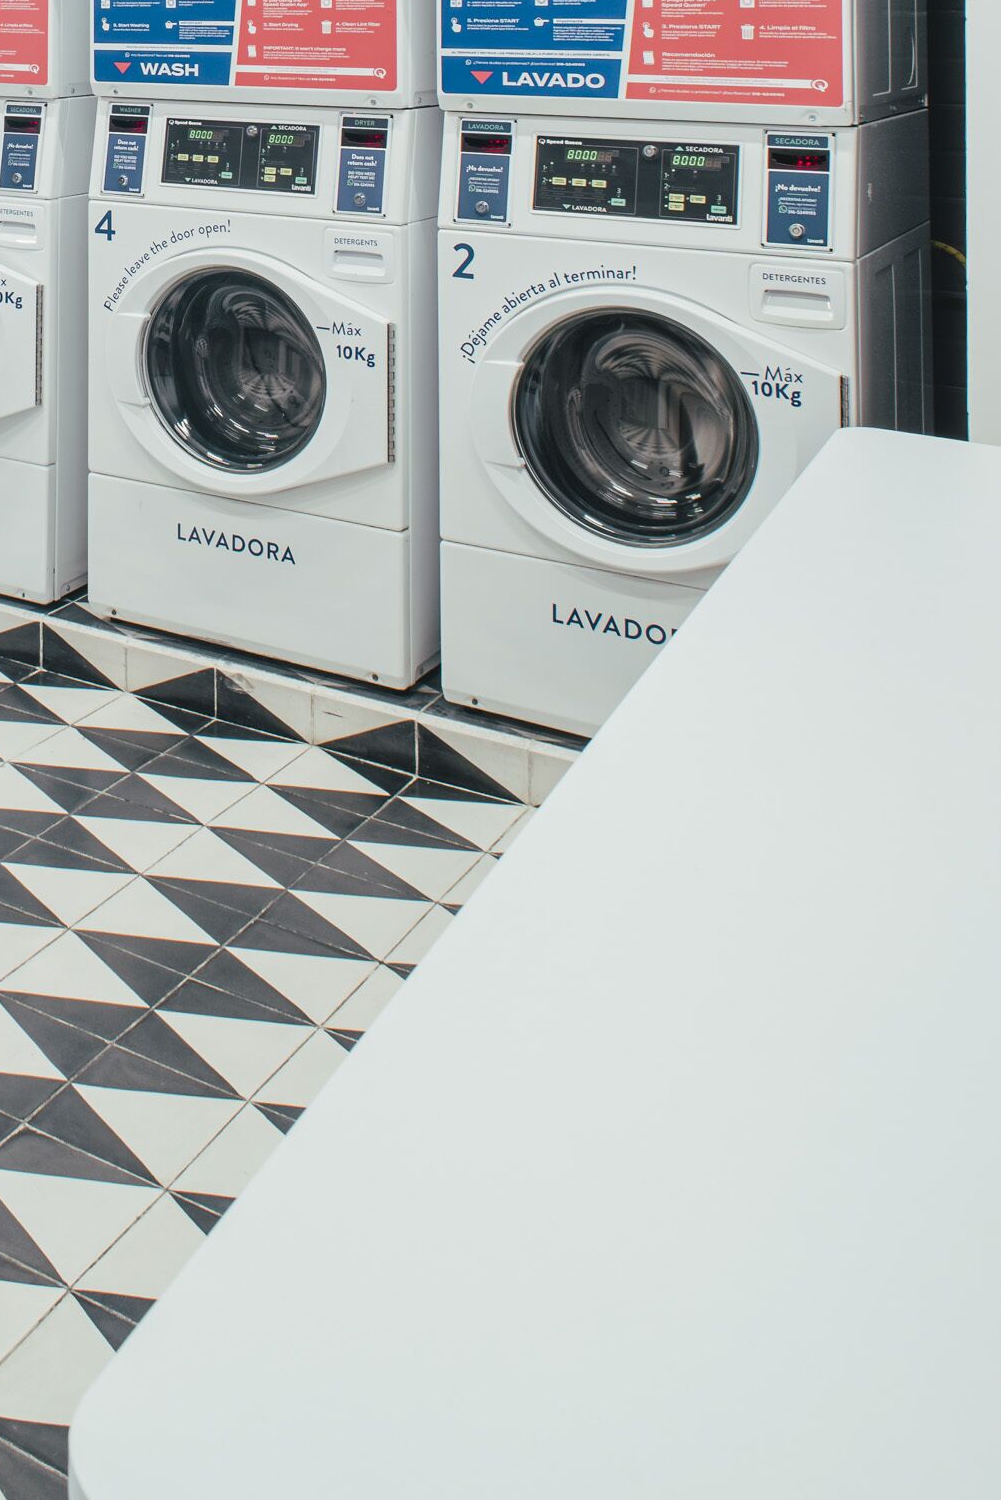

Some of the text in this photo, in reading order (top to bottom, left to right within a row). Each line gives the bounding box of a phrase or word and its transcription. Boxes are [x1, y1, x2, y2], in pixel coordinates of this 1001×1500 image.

[140, 63, 200, 77] WASH
[502, 71, 606, 89] LAVADO
[467, 123, 505, 131] LAVADORA
[189, 130, 213, 140] 8000
[268, 134, 294, 145] 8000
[775, 137, 820, 146] SECADORA
[567, 149, 598, 161] 8000
[685, 145, 724, 154] SECADORA
[672, 155, 705, 167] 8000
[789, 184, 821, 193] devuelve!
[571, 204, 607, 213] LAVADORA
[94, 210, 117, 242] 4
[334, 237, 378, 247] DETERGENTS
[103, 219, 232, 313] Please leave the door open!
[452, 243, 475, 280] 2
[762, 272, 827, 285] DETERGENTES
[459, 265, 638, 365] ¡Déjame abierta al terminar!
[331, 321, 362, 337] Máx
[336, 344, 375, 369] 10Kg
[764, 365, 804, 384] Máx
[750, 380, 802, 408] 10Kg
[177, 522, 297, 566] LAVADORA
[551, 602, 678, 645] LAVADO
